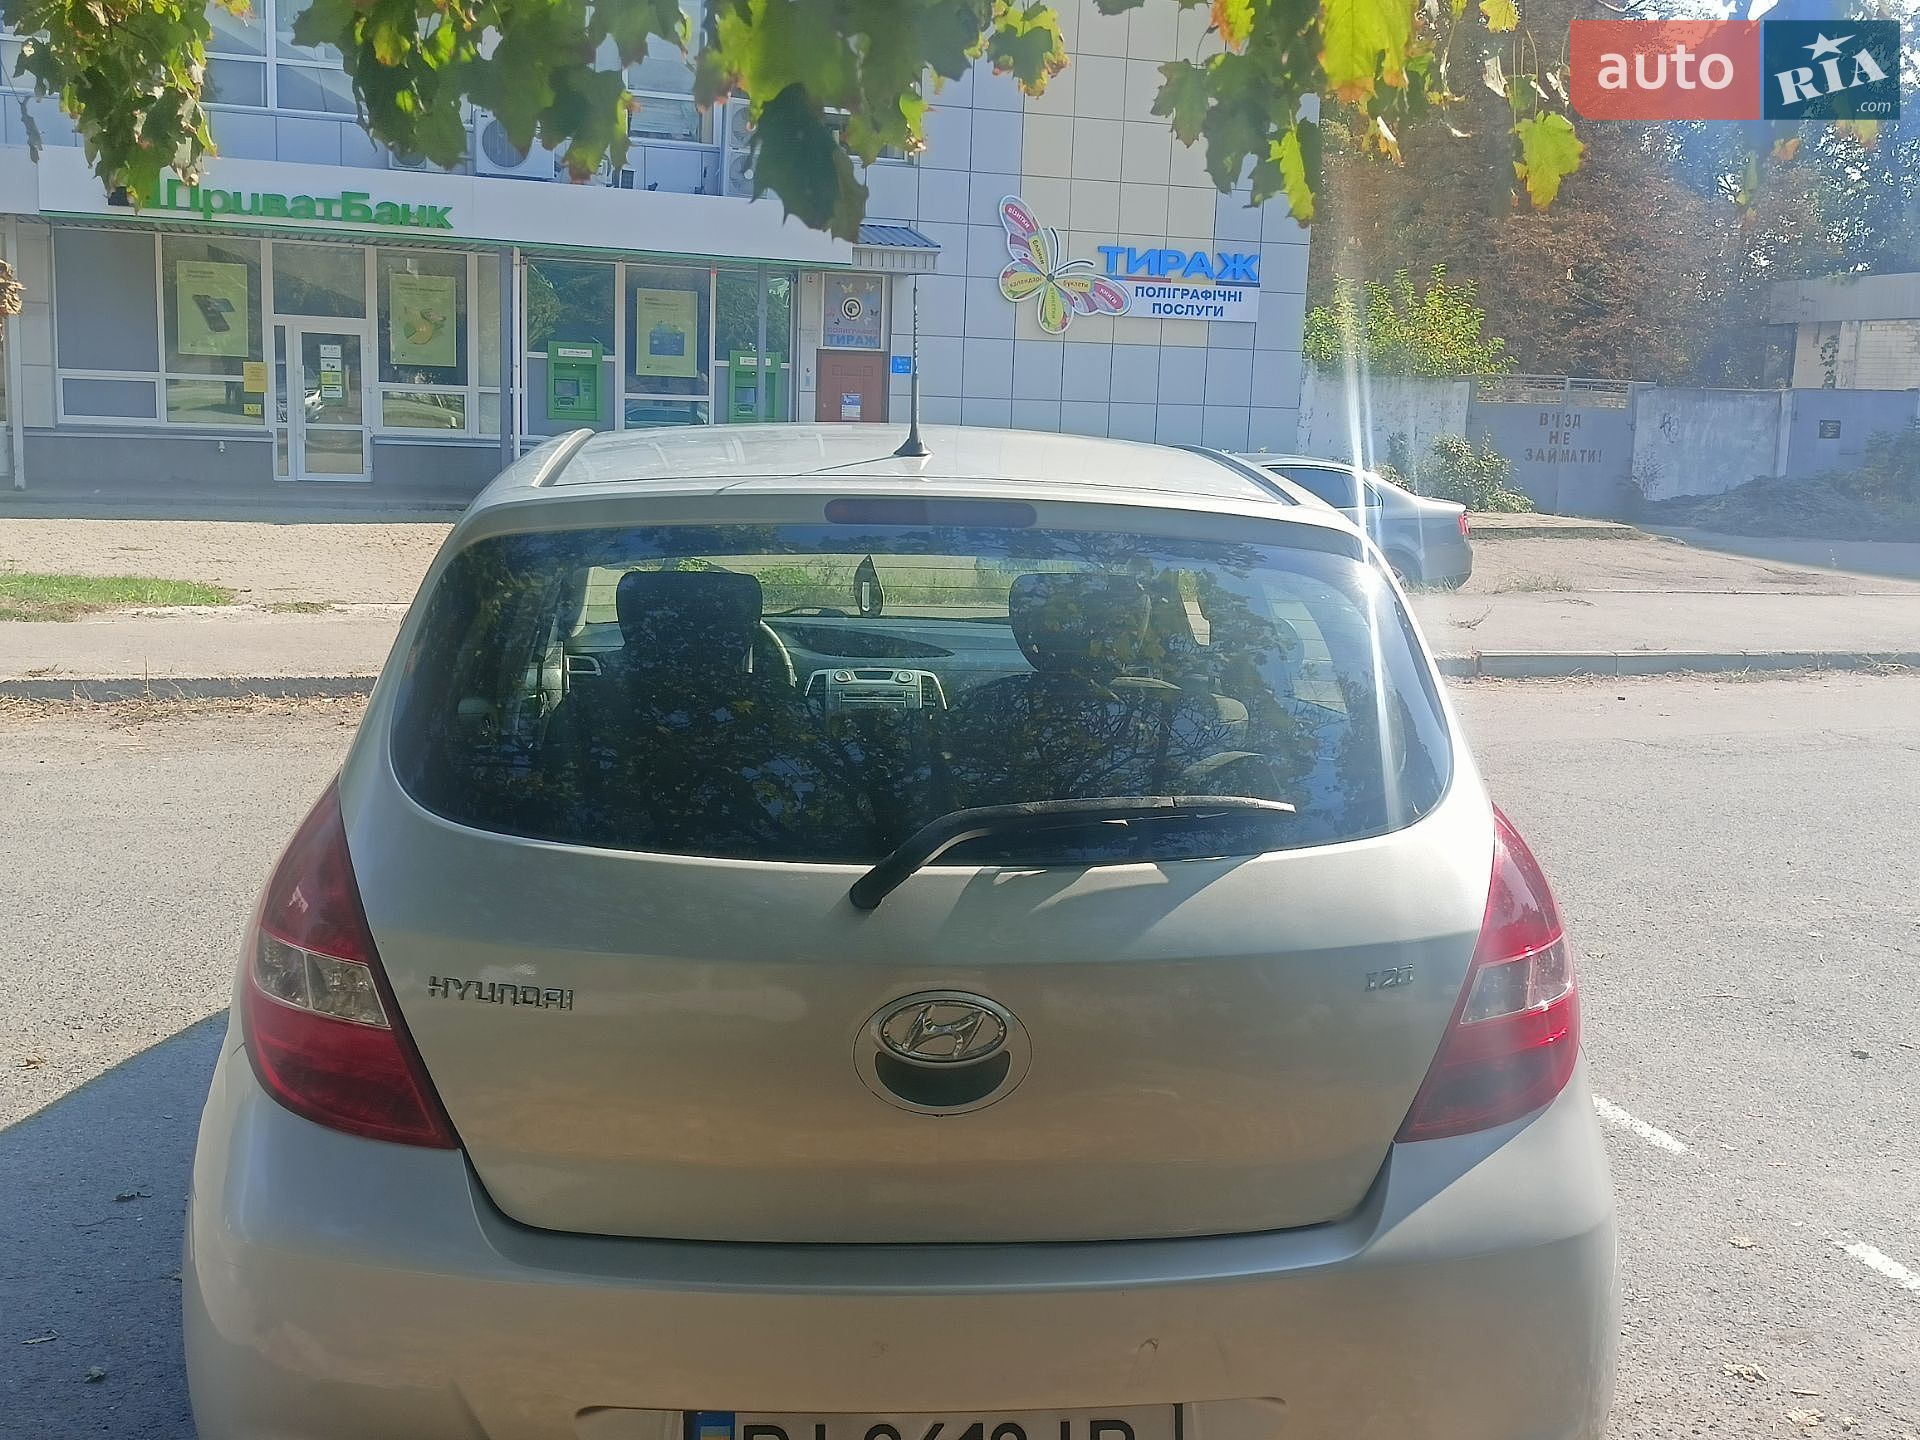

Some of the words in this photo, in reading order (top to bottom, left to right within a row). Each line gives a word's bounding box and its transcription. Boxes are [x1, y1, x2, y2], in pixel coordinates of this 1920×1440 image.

[166, 178, 455, 229] ПриватБанк
[1098, 245, 1259, 281] ТИРАЖ
[1134, 285, 1243, 303] ПОЛІГРАФІЧНІ
[1152, 302, 1224, 318] ПОСЛУГИ
[827, 334, 878, 347] ТИРАЖ
[1548, 430, 1571, 445] НЕ
[428, 975, 575, 1011] HYUNDAI
